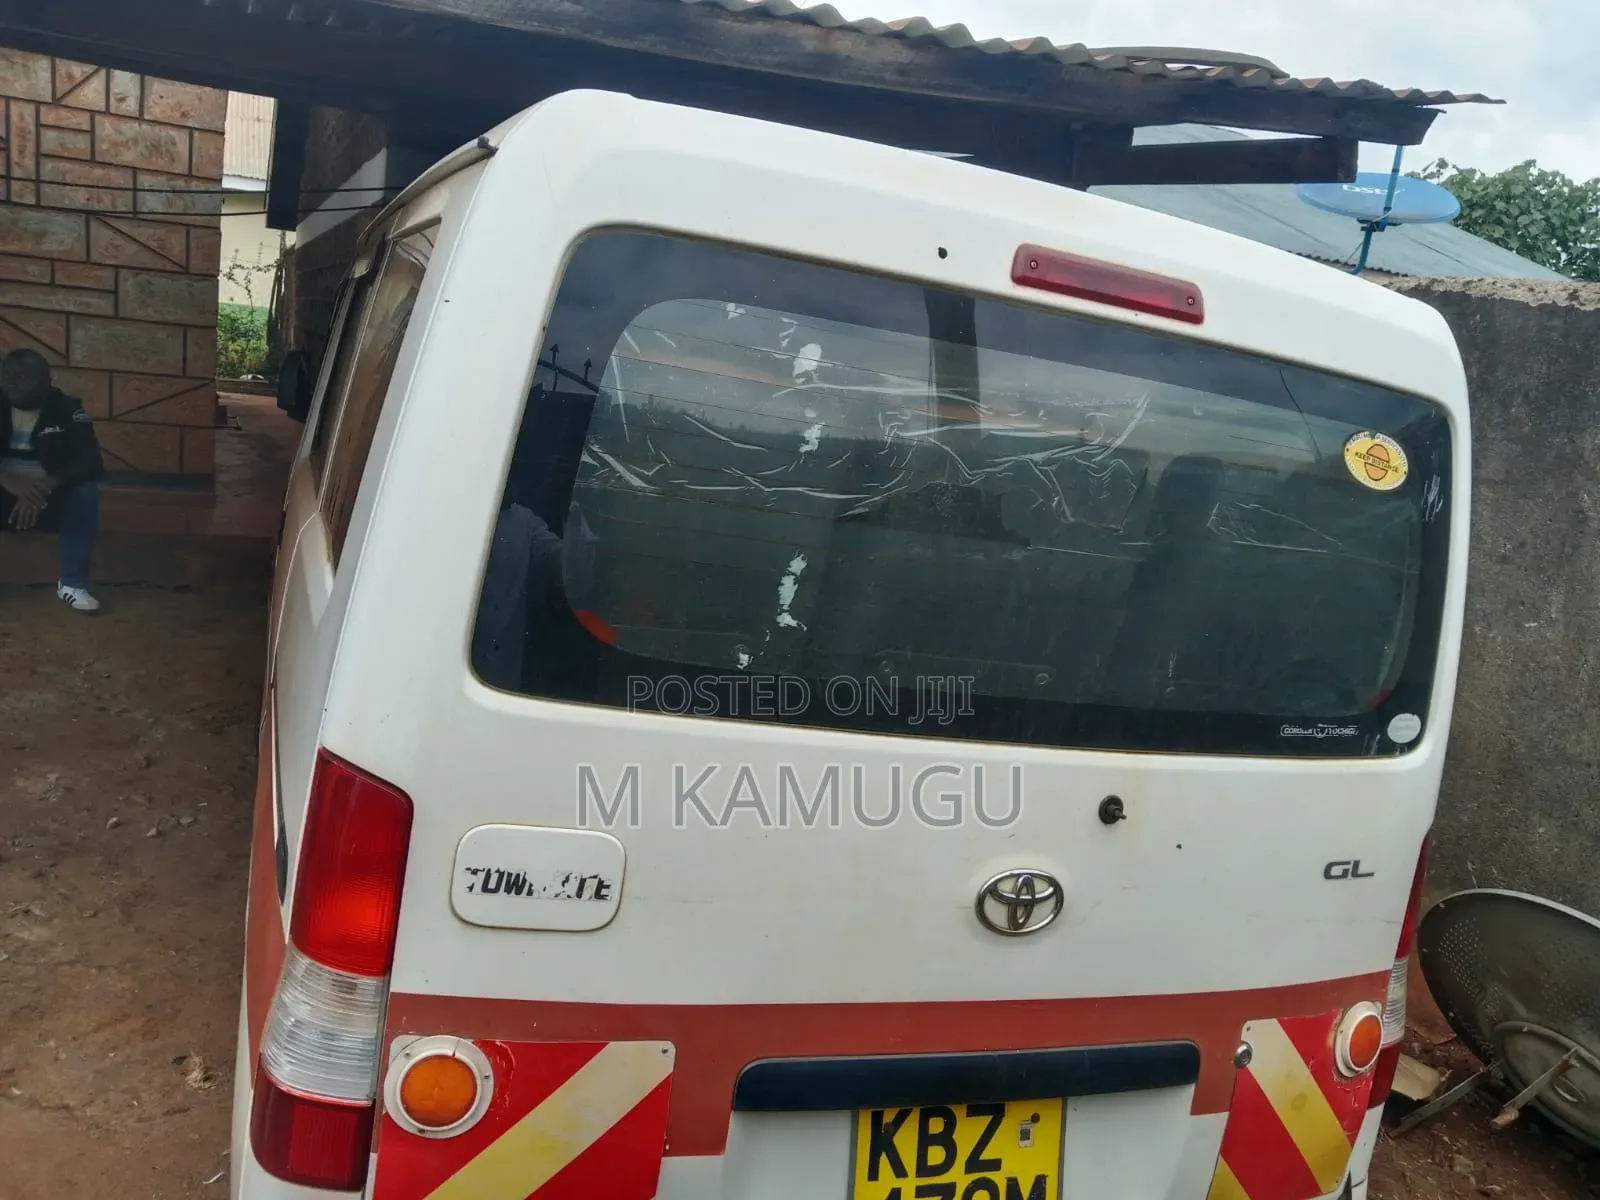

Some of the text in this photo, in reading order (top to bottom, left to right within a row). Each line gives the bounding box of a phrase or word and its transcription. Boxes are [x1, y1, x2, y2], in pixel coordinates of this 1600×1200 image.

[1354, 451, 1399, 473] KEEP DISTANCE
[1323, 859, 1375, 880] GL
[867, 1102, 1007, 1182] KBZ
